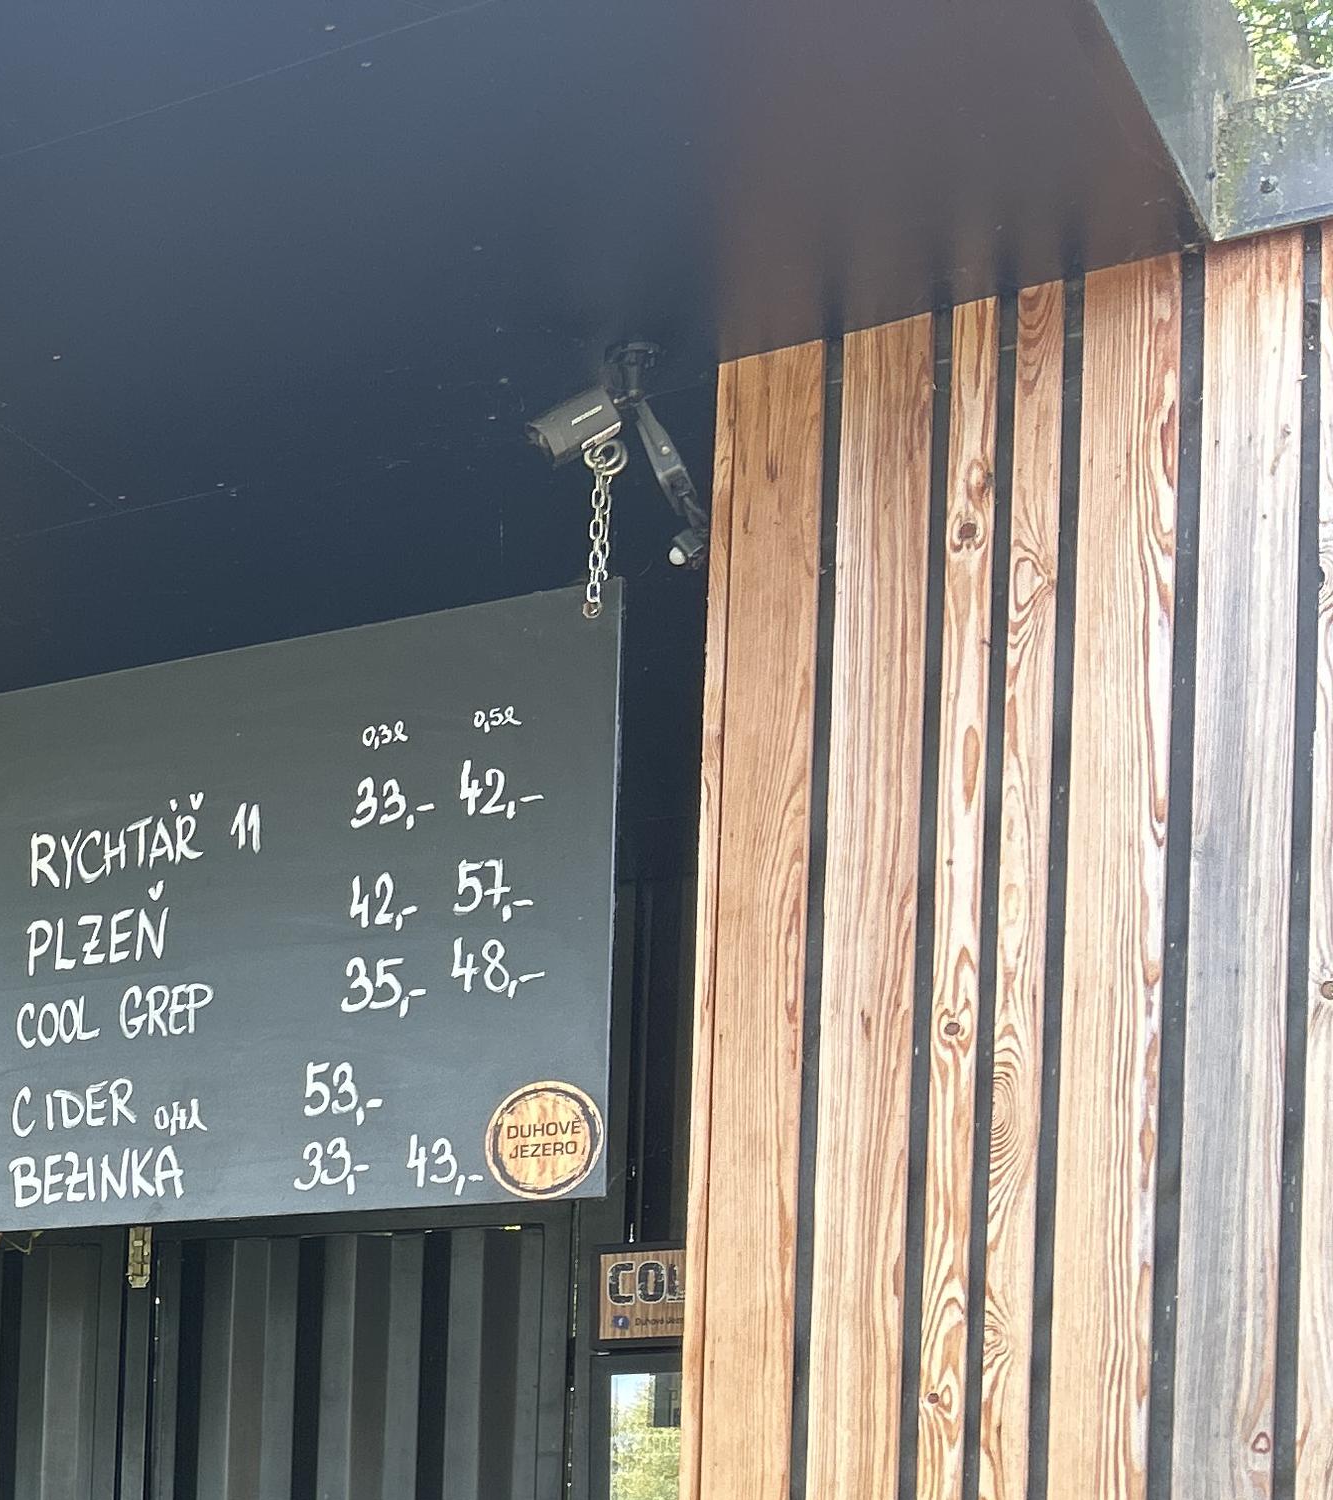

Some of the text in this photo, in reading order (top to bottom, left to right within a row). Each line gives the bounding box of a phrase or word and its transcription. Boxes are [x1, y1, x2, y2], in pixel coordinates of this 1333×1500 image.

[362, 705, 522, 750] 0,3l 0,5l
[350, 759, 545, 831] 33,- 42,-
[230, 802, 262, 854] 11
[349, 858, 534, 932] 42,- 57,-
[26, 879, 170, 977] PLZEŇ
[340, 936, 546, 1018] 35,- 48,-
[16, 982, 214, 1049] COOL GREP
[11, 1077, 137, 1138] CIDER
[303, 1061, 383, 1126] 53,-
[293, 1133, 484, 1197] 33,- 43,-
[509, 1140, 577, 1160] JEZERO
